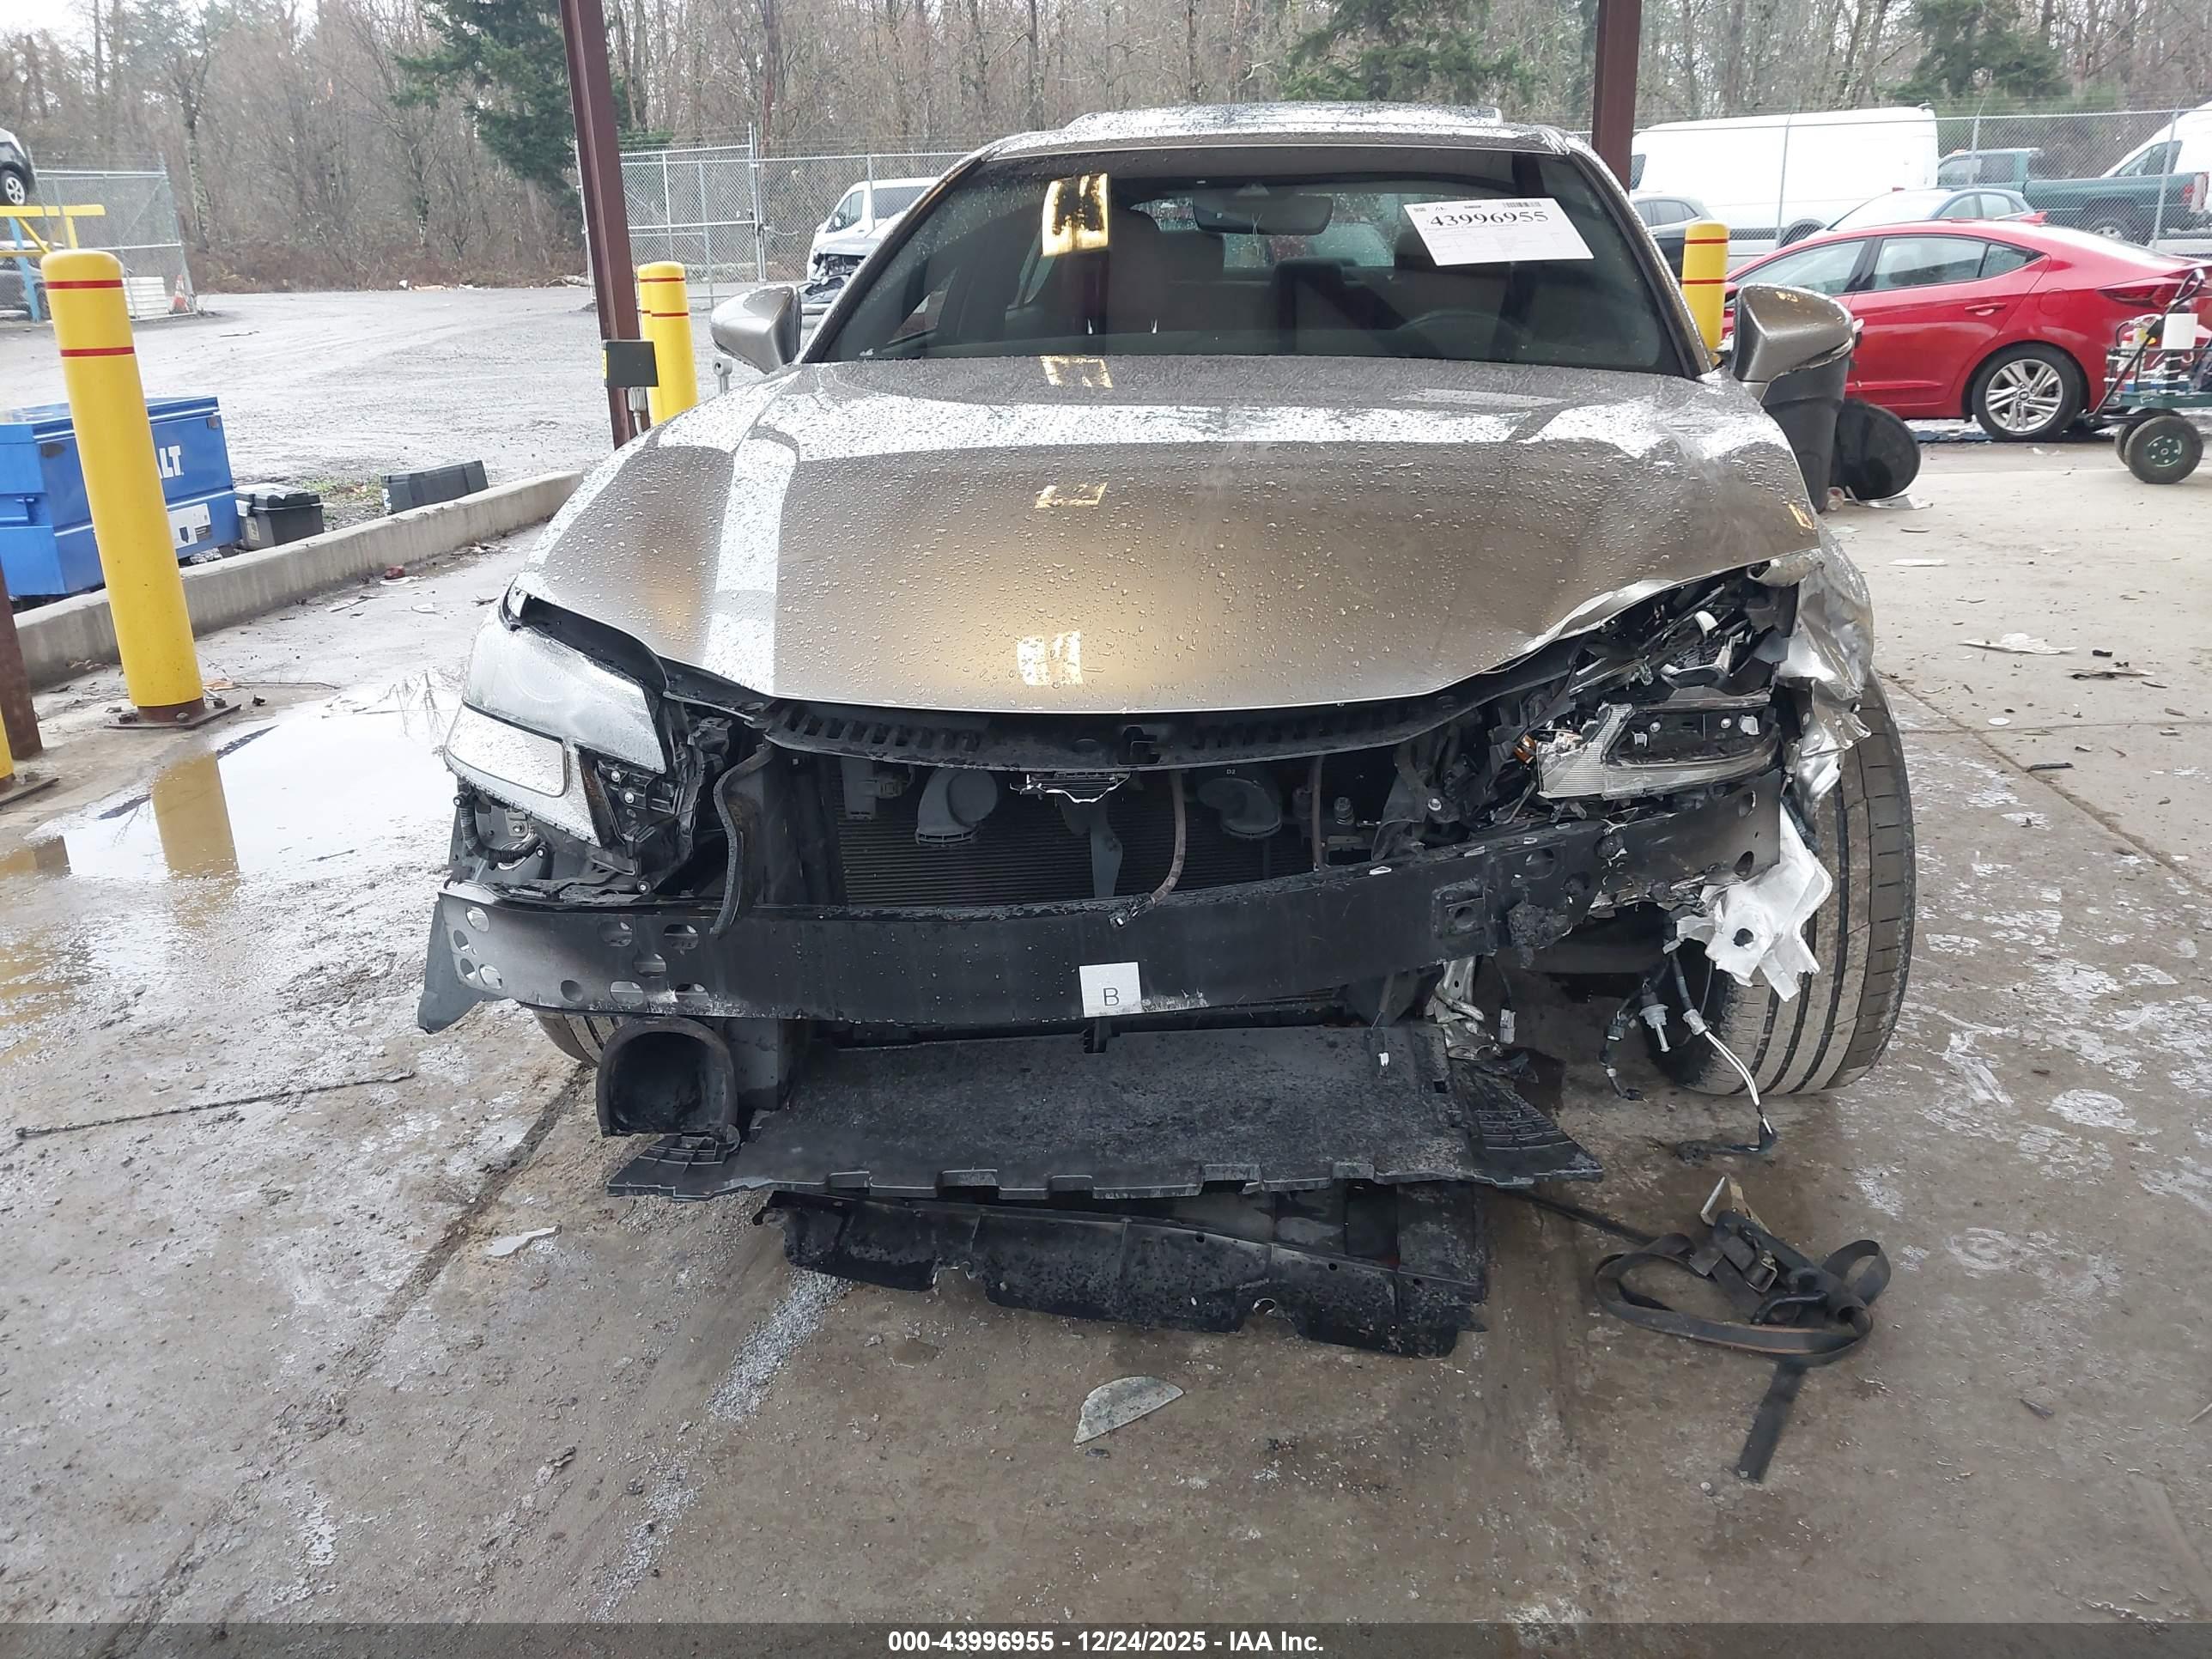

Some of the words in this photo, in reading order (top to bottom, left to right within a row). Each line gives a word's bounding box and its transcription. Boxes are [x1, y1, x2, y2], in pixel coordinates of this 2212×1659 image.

[1431, 211, 1548, 226] 43996955
[158, 446, 181, 478] LT
[1103, 988, 1120, 1006] B
